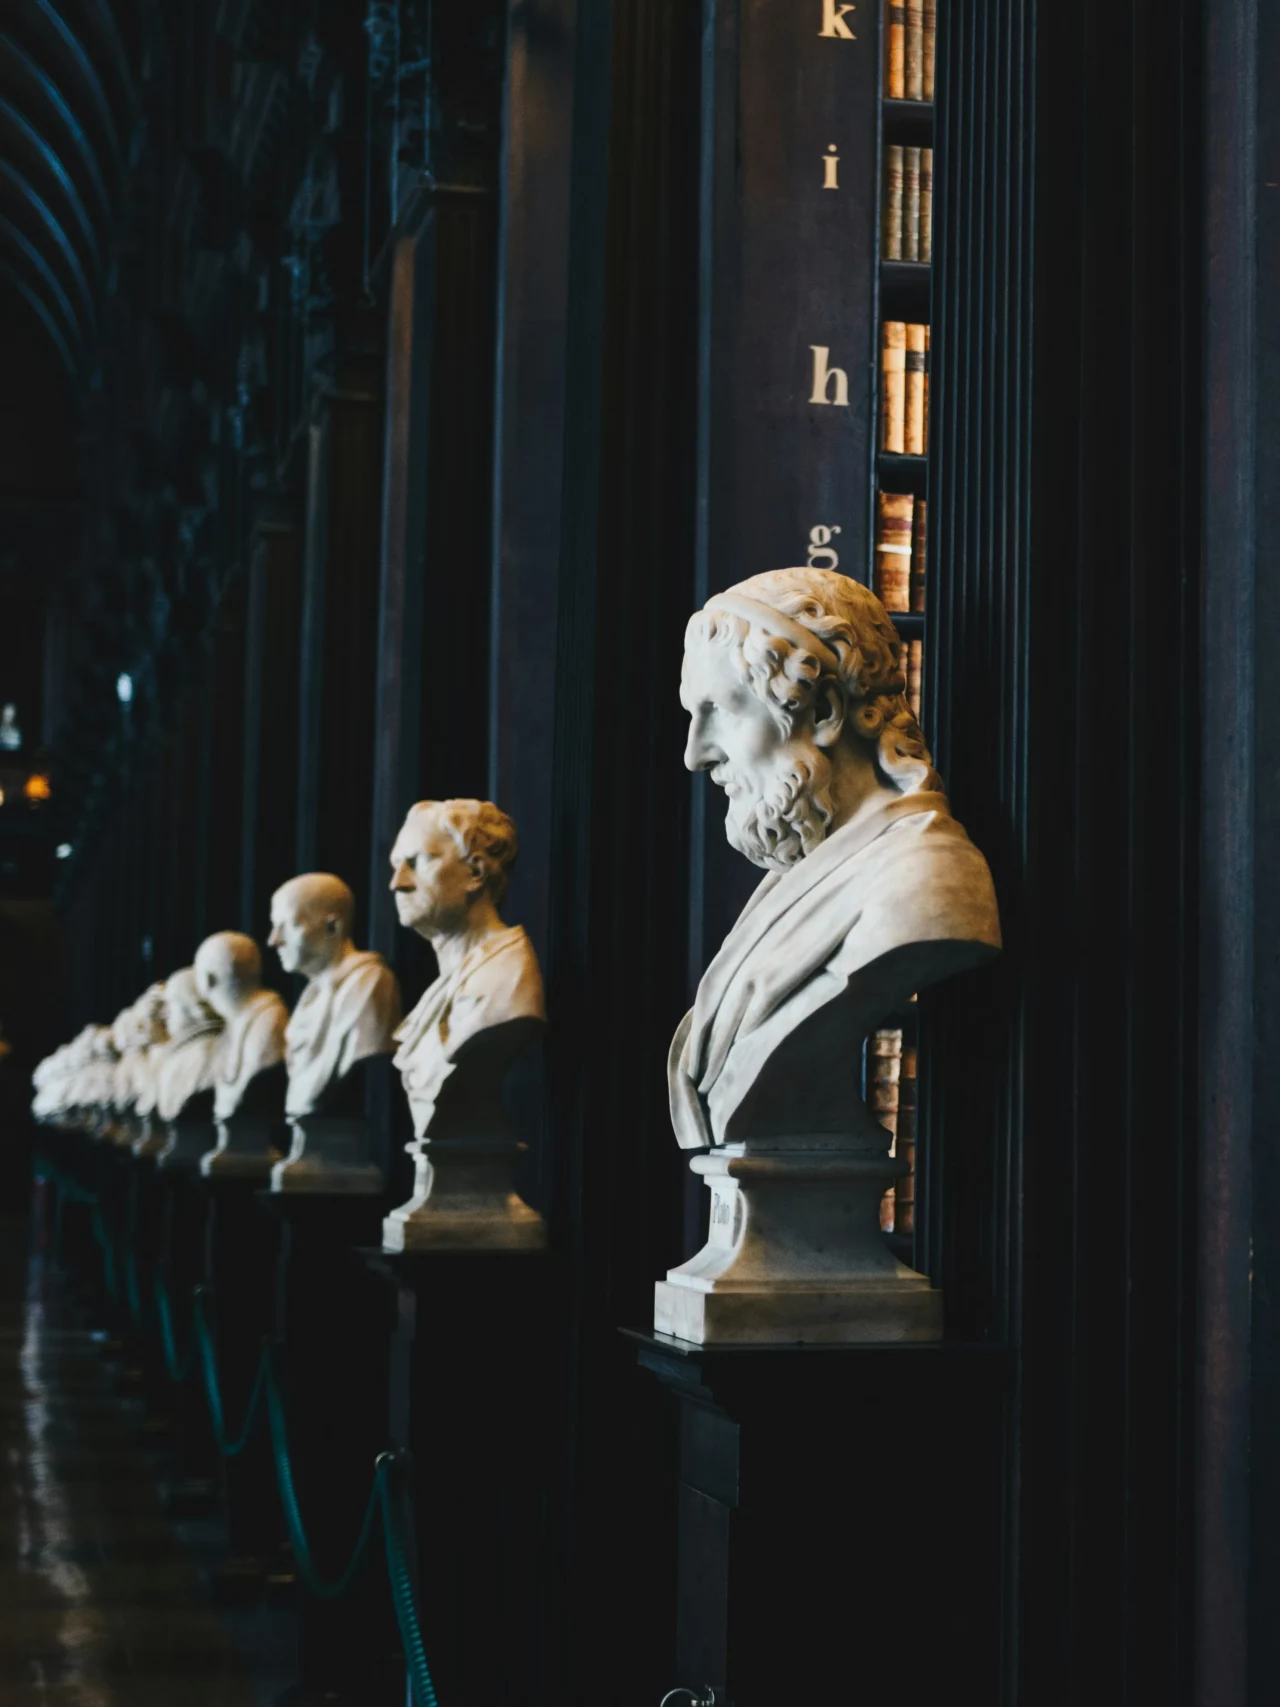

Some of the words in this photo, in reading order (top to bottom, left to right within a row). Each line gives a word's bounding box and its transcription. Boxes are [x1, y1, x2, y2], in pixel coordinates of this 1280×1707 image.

[818, 0, 856, 40] k
[822, 144, 840, 189] i
[808, 345, 849, 407] h
